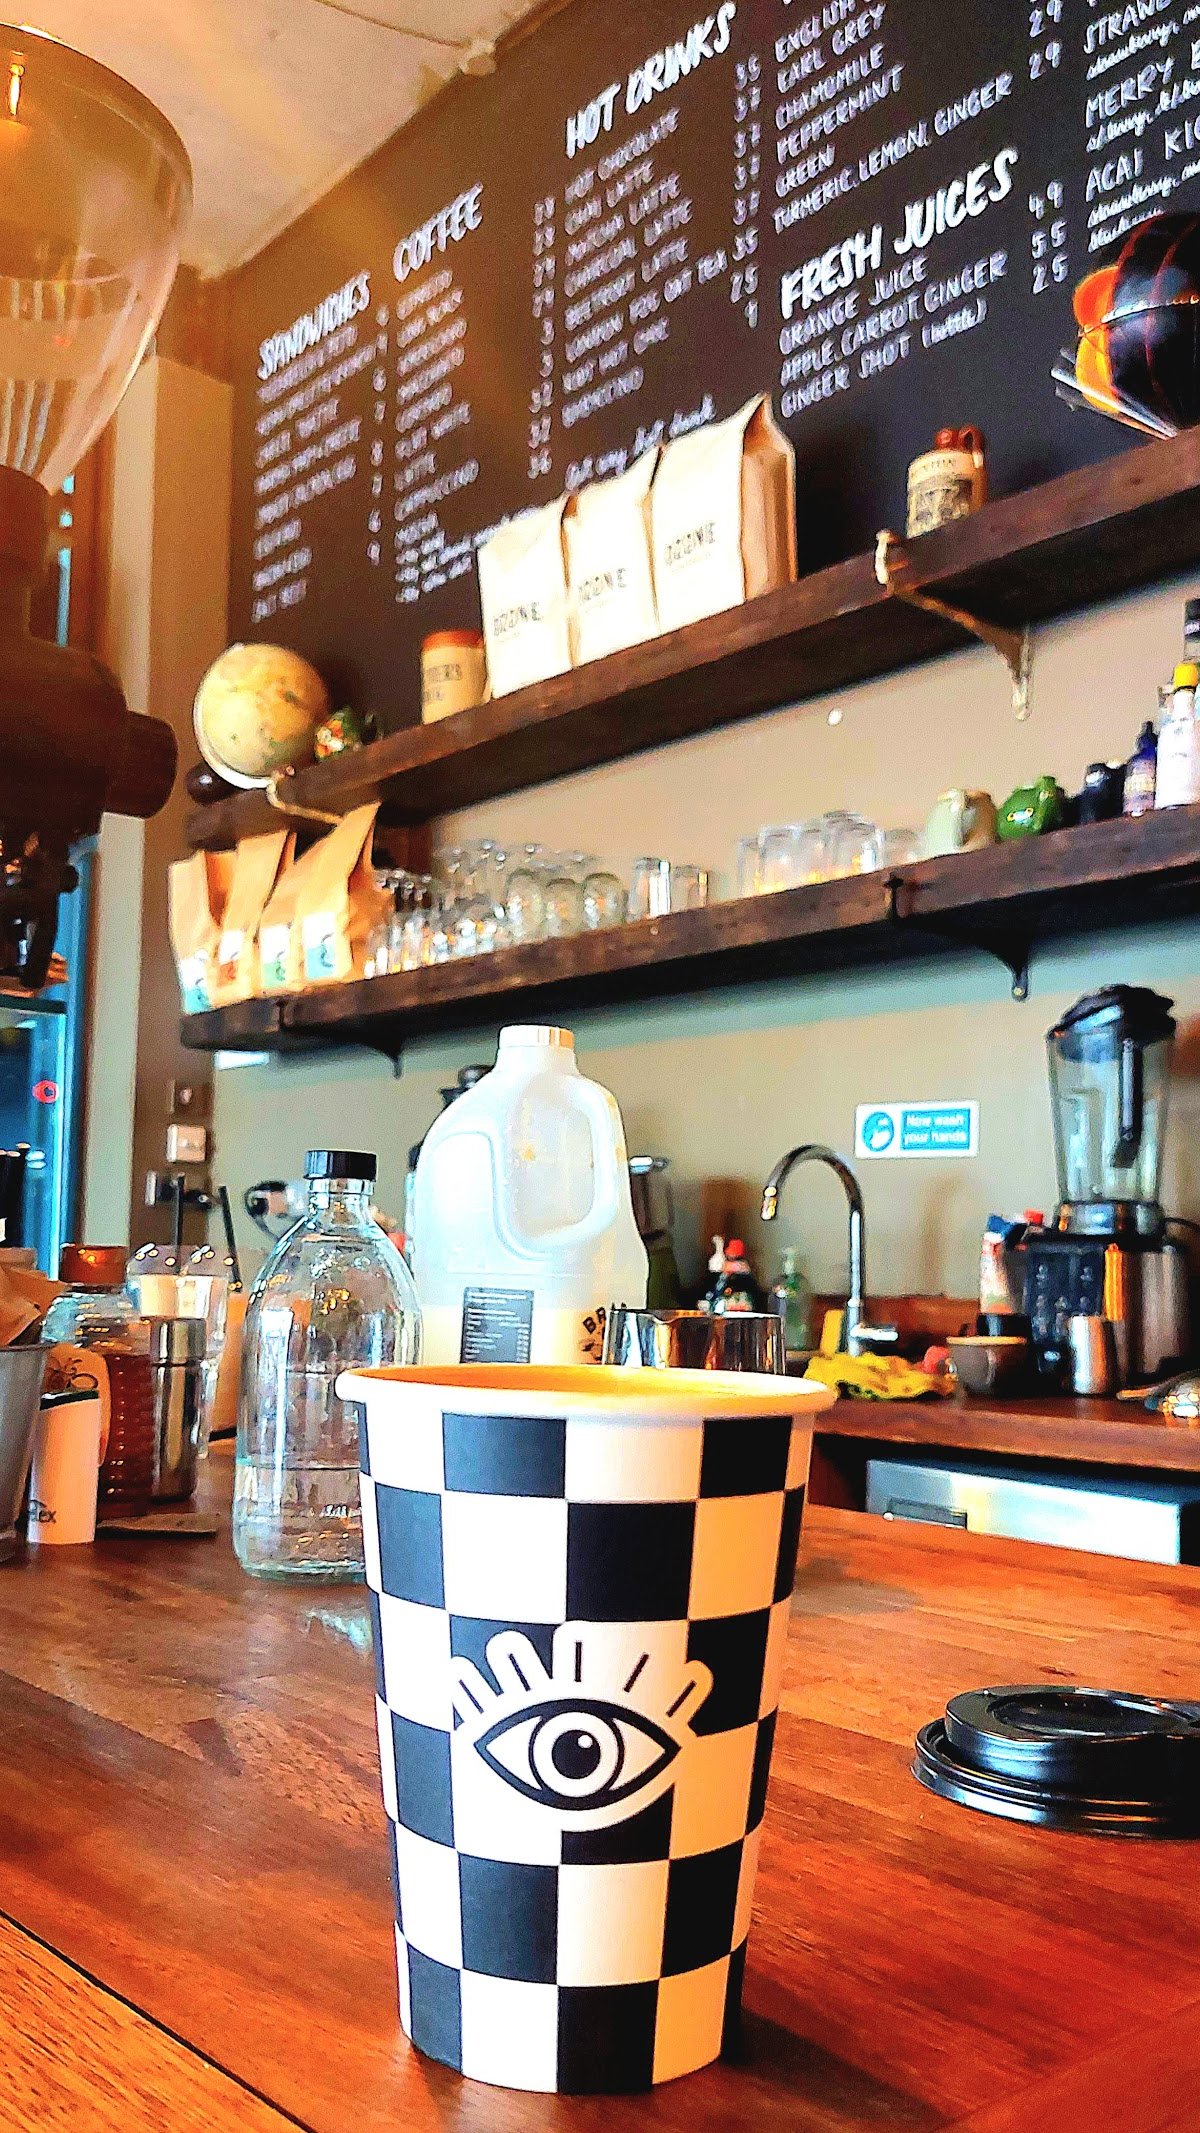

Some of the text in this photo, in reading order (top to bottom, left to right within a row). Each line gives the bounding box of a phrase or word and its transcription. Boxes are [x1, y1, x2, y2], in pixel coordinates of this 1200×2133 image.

[775, 0, 856, 62] ENGLISH
[777, 47, 827, 93] EARL
[832, 3, 886, 55] GREY
[566, 1, 737, 159] HOT DRINKS
[775, 42, 885, 131] CHAMOMILE
[777, 62, 905, 164] PEPPERMINT
[934, 70, 1014, 136] GINGER
[1086, 56, 1176, 128] MERRY
[629, 172, 681, 225] LATTE
[775, 144, 835, 198] GREEN
[1085, 147, 1143, 203] ACAI
[393, 181, 483, 282] COFFEE
[780, 146, 1018, 320] FRESH JUICES
[779, 291, 861, 355] ORANGE
[869, 253, 928, 306] JUICE
[924, 250, 1008, 313] GINGER
[257, 269, 371, 380] SANDWICHES
[780, 363, 850, 418] GINGER
[858, 331, 912, 379] SHOT
[904, 1131, 967, 1146] your hands
[906, 1113, 964, 1127] Now wash
